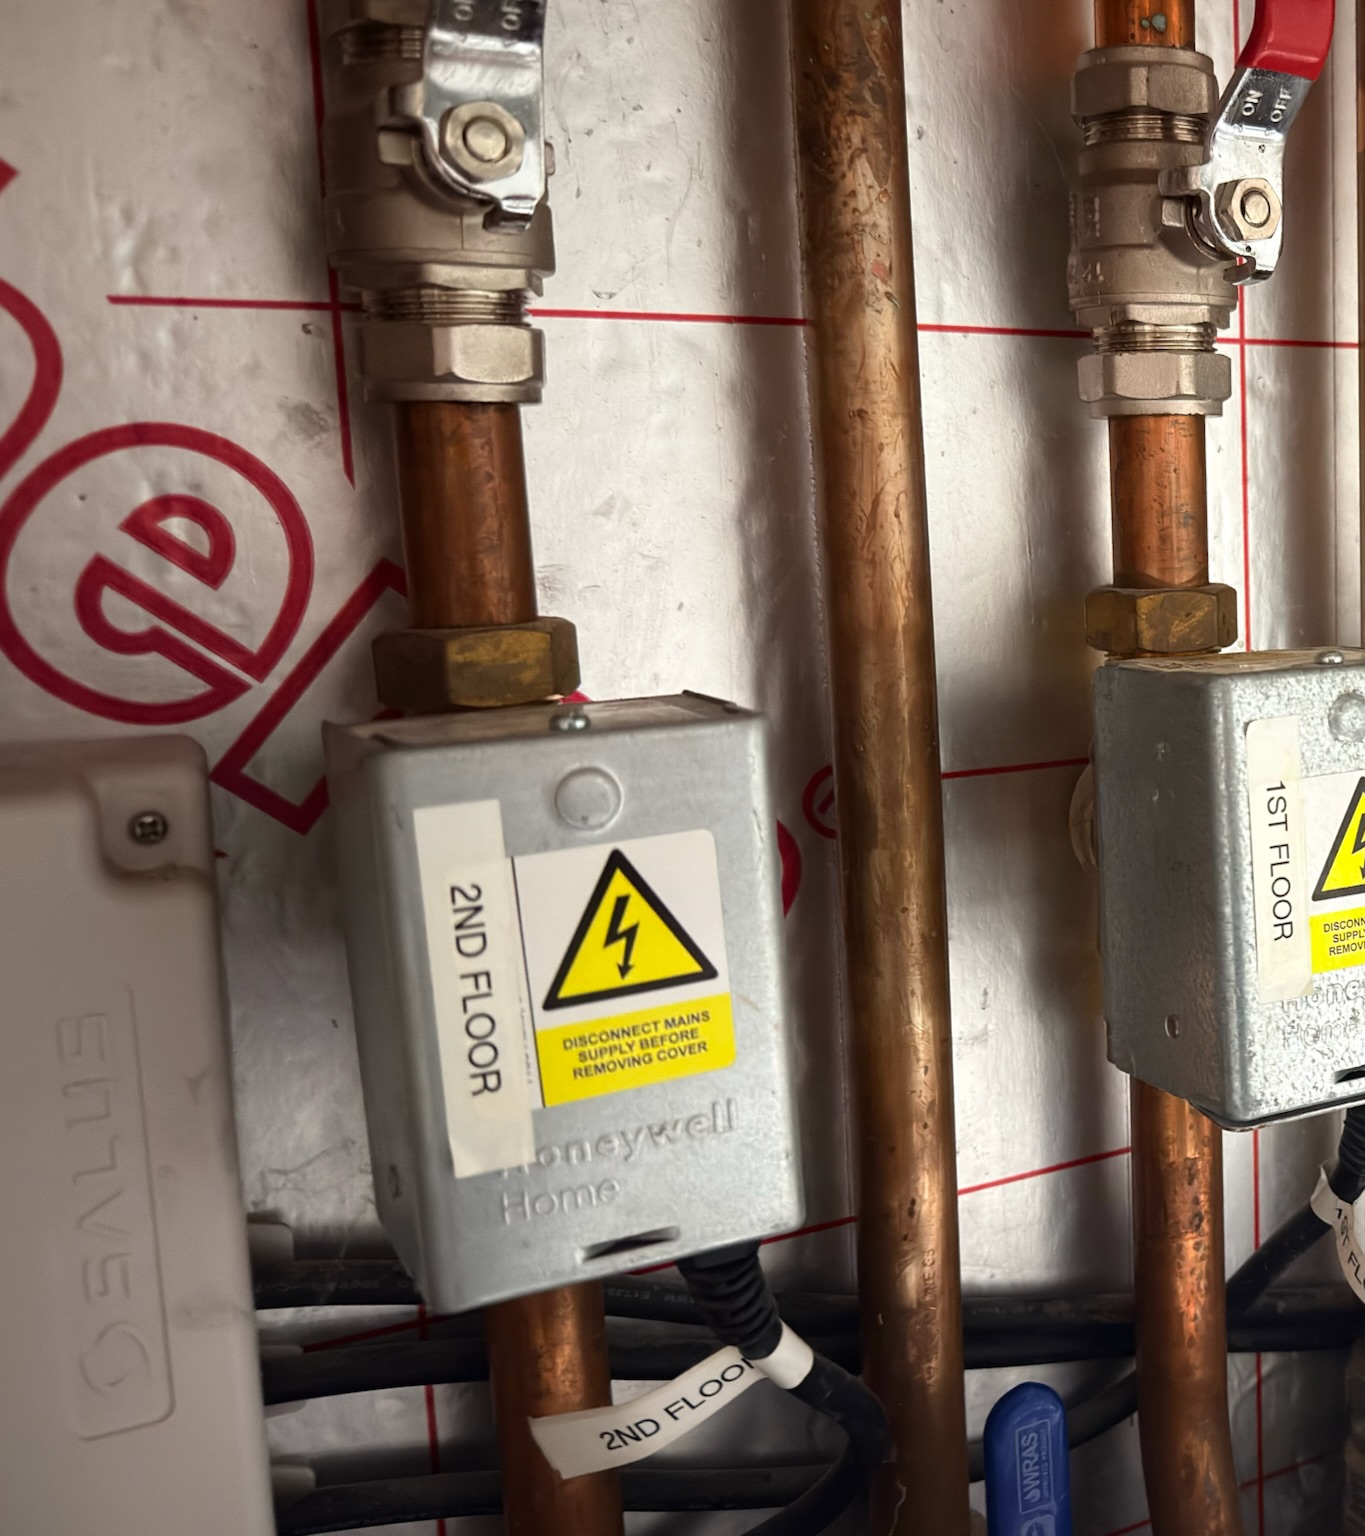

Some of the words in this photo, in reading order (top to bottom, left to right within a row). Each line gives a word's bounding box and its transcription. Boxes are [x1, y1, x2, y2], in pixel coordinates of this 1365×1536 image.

[1242, 90, 1263, 116] ON
[1270, 87, 1293, 123] OFF
[1266, 780, 1288, 832] 1ST
[1269, 843, 1294, 941] FLOOR
[450, 883, 487, 958] 2ND
[460, 970, 502, 1097] FLOOR
[563, 1020, 661, 1050] DISCONNECT
[664, 1010, 711, 1029] MAINS
[578, 1040, 636, 1063] SUPPLY
[639, 1028, 700, 1050] BEFORE
[573, 1052, 653, 1080] REMOVING
[657, 1041, 708, 1062] COVER
[503, 1098, 738, 1180] oneywell
[503, 1178, 620, 1225] Home
[599, 1418, 660, 1451] 2ND
[1021, 1432, 1040, 1492] WRAS
